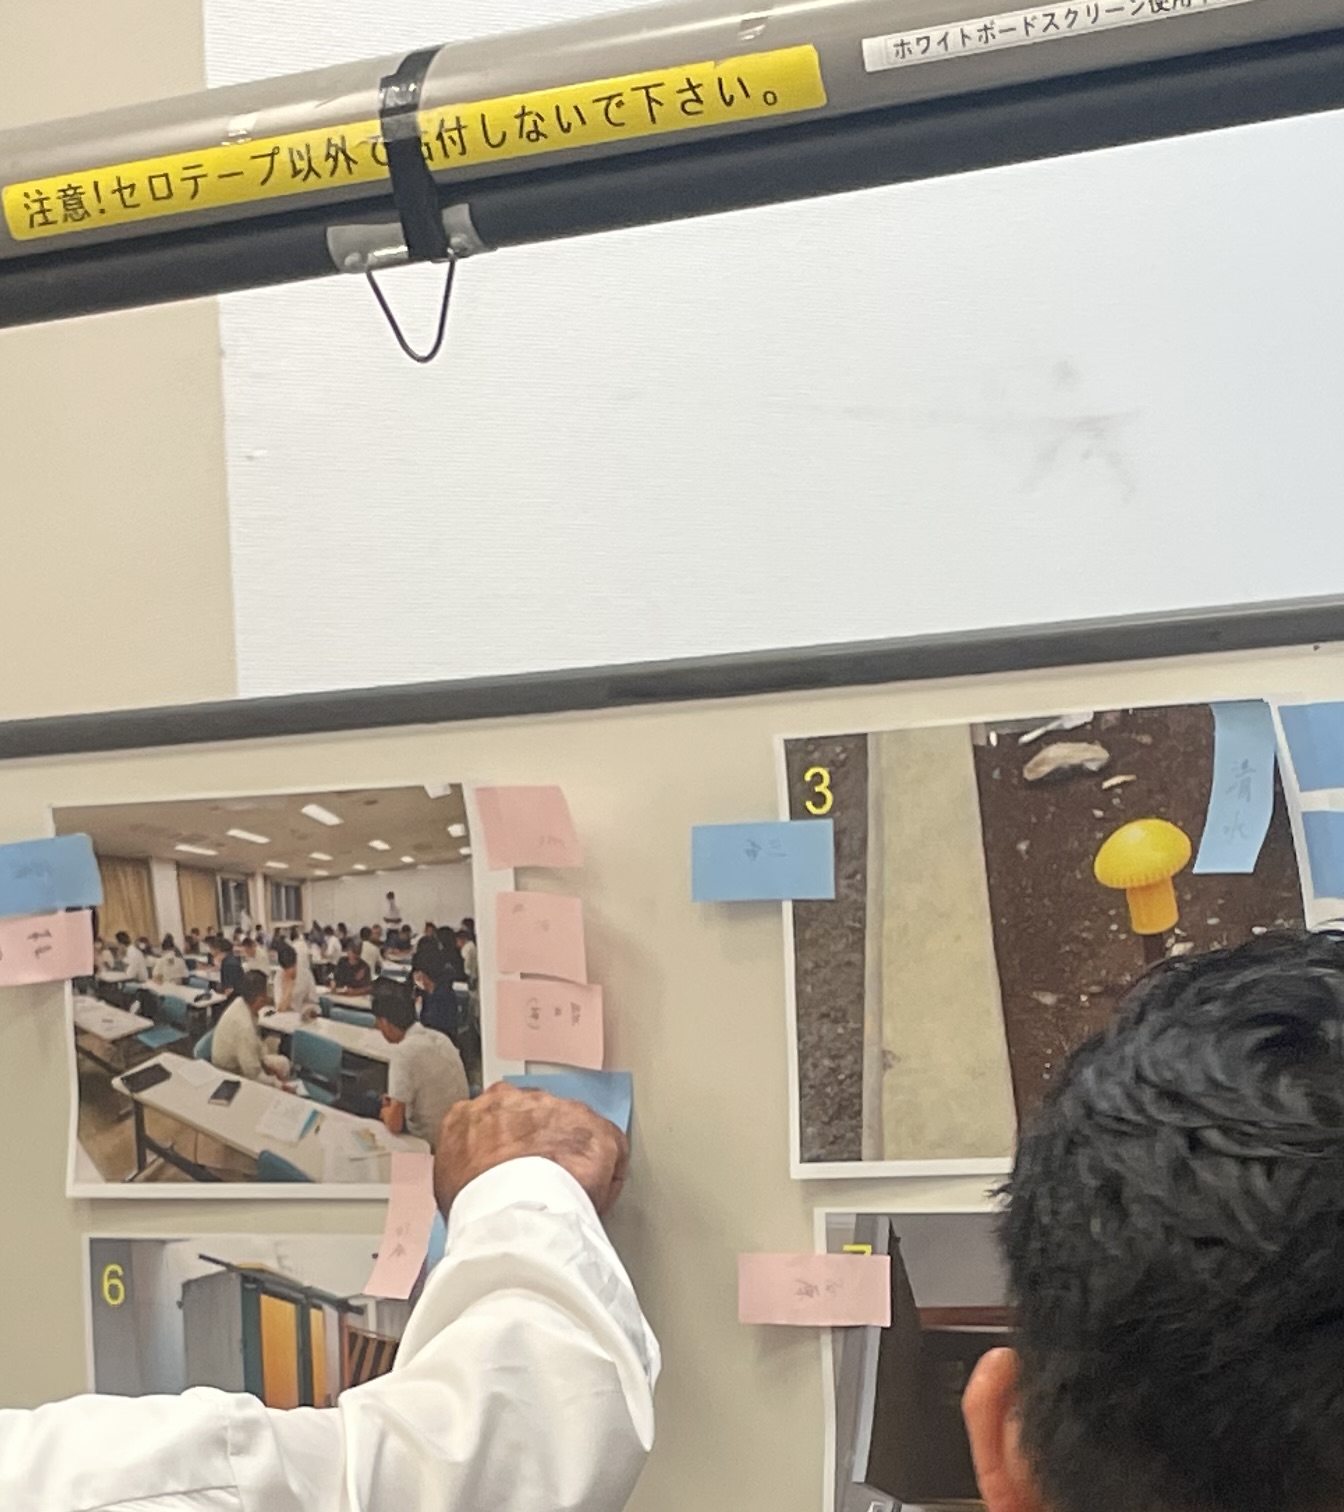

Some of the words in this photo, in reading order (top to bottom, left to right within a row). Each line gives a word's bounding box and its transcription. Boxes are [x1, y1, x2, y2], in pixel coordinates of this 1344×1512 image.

[23, 76, 778, 229] 注意!セロテープ以外で付しないで下さい。
[803, 766, 834, 815] 3
[102, 1263, 125, 1306] 6
